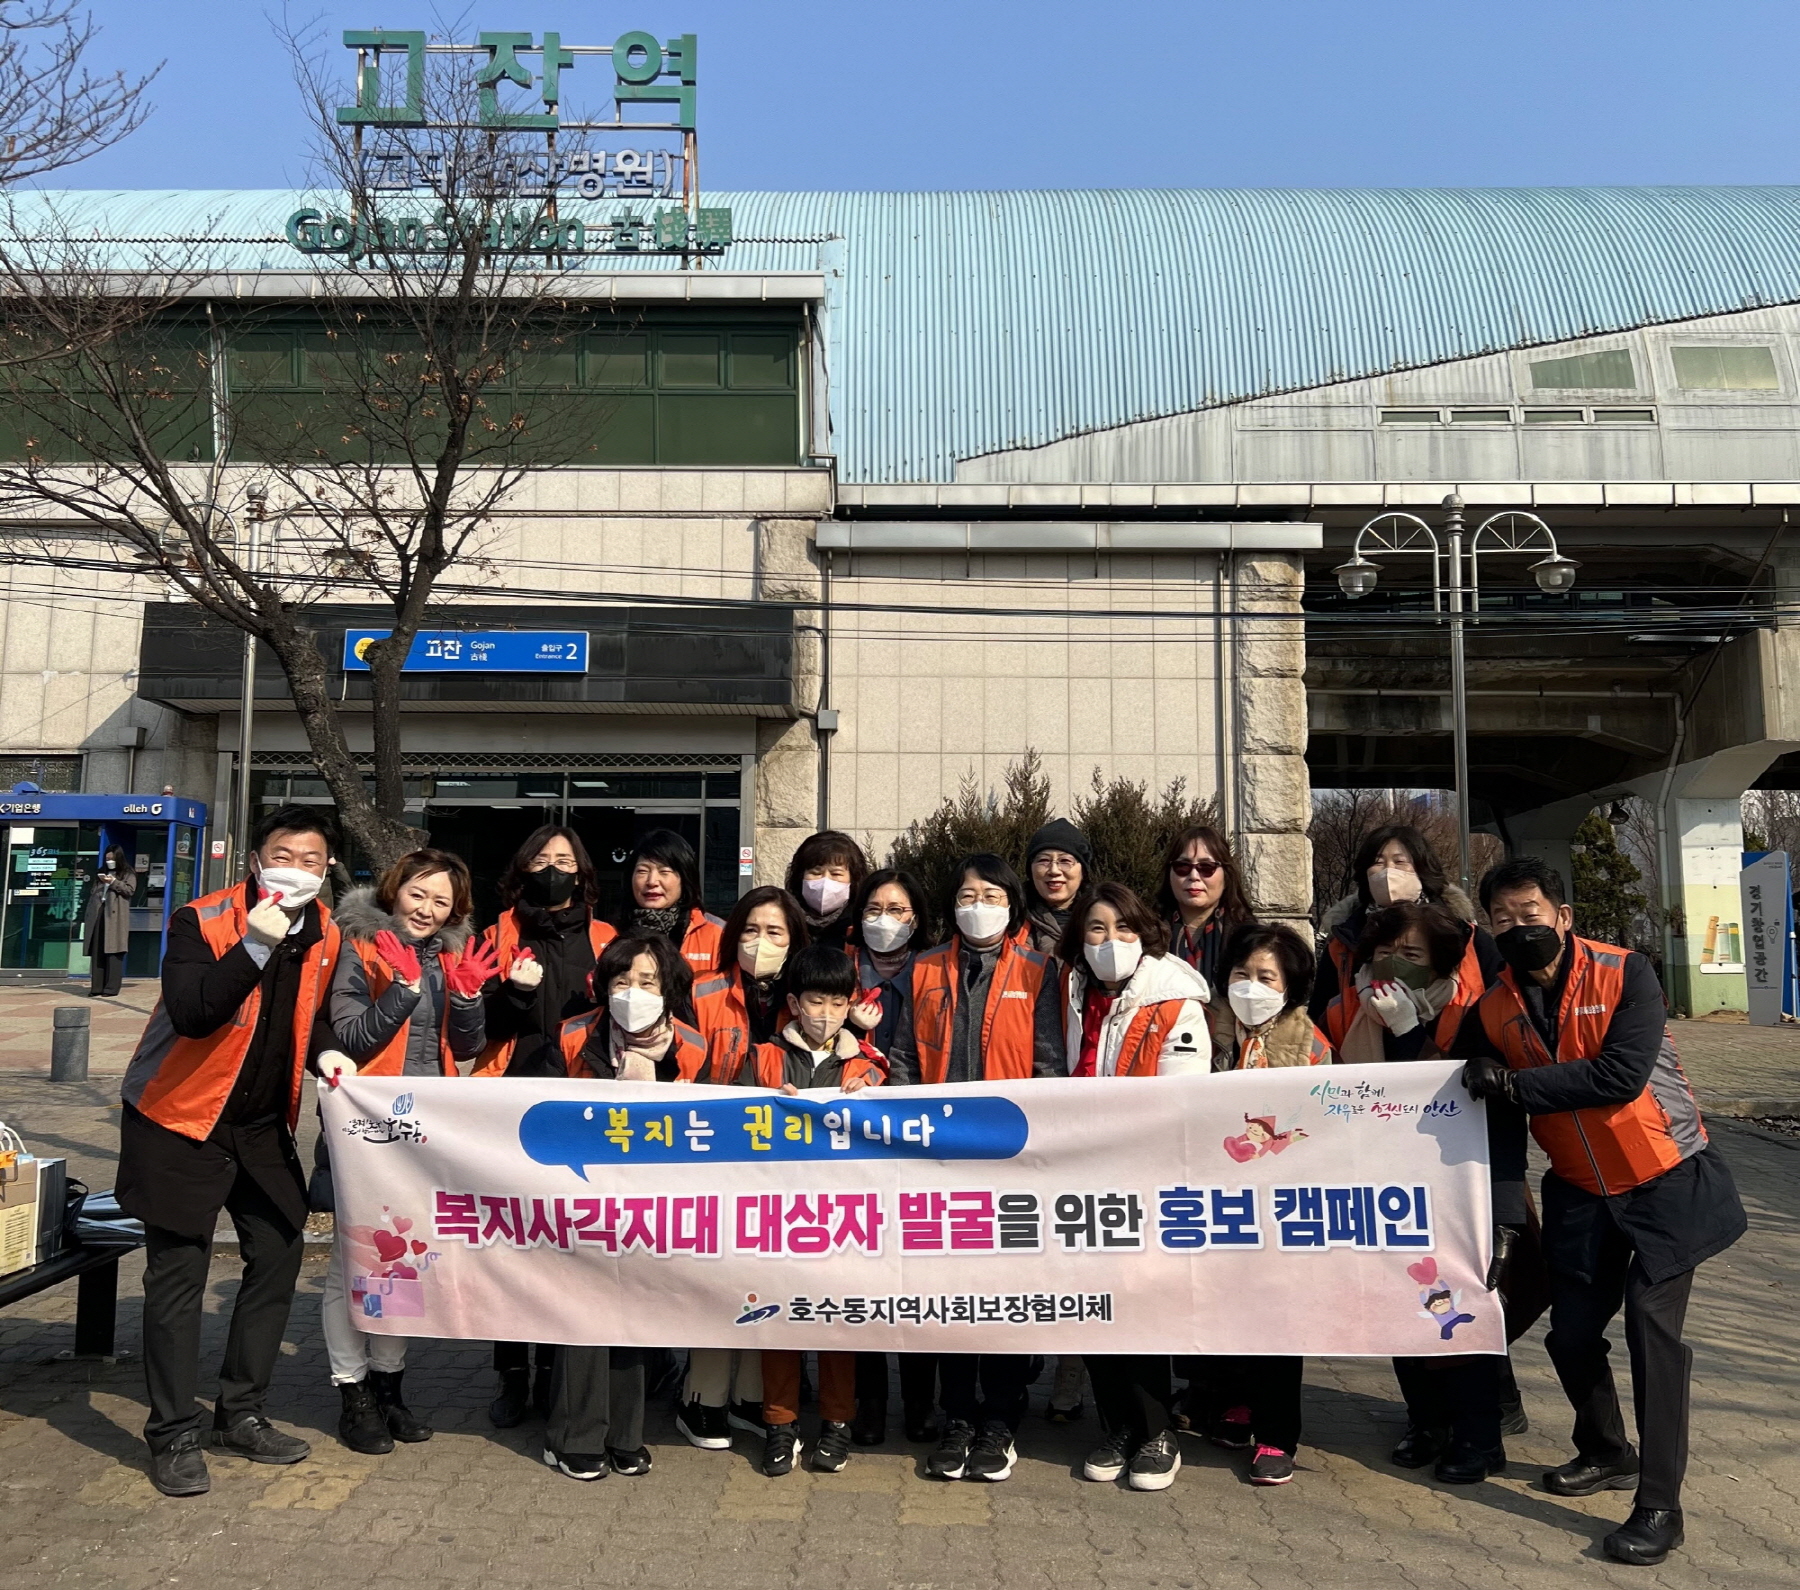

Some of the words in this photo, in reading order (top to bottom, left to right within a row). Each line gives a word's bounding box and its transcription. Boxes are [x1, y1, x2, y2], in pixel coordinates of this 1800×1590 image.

[336, 31, 697, 130] 고잔역
[425, 639, 462, 660] 고잔
[470, 641, 496, 652] Gojan
[565, 643, 578, 660] 2
[123, 804, 148, 813] olleh
[1370, 1101, 1419, 1122] 혁신도시
[1423, 1100, 1462, 1118] 안산
[435, 1191, 718, 1254] 복지사각지대
[736, 1193, 883, 1253] 대상자
[899, 1191, 1040, 1251] 발굴을
[1054, 1193, 1143, 1247] 위한
[1159, 1186, 1260, 1248] 홍보
[1274, 1186, 1430, 1247] 캠페인
[788, 1294, 1113, 1325] 호수동지역사회보장협의체
